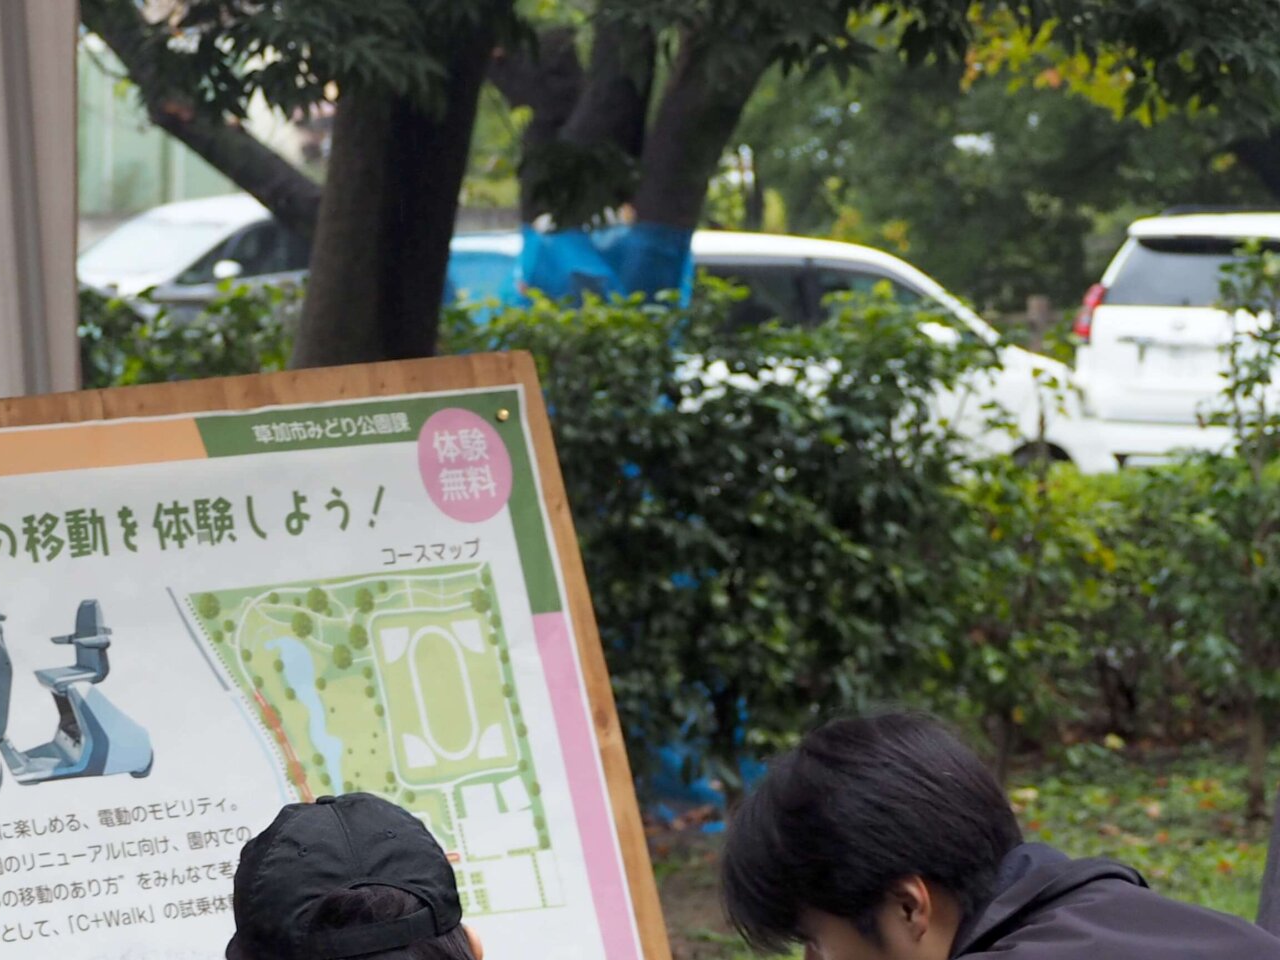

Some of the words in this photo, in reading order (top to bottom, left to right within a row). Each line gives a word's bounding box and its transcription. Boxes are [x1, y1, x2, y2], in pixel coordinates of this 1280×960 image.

[252, 412, 412, 444] 草加市みどり公園課
[433, 429, 489, 464] 体験
[439, 465, 497, 501] 無料
[381, 538, 481, 566] コースマップ
